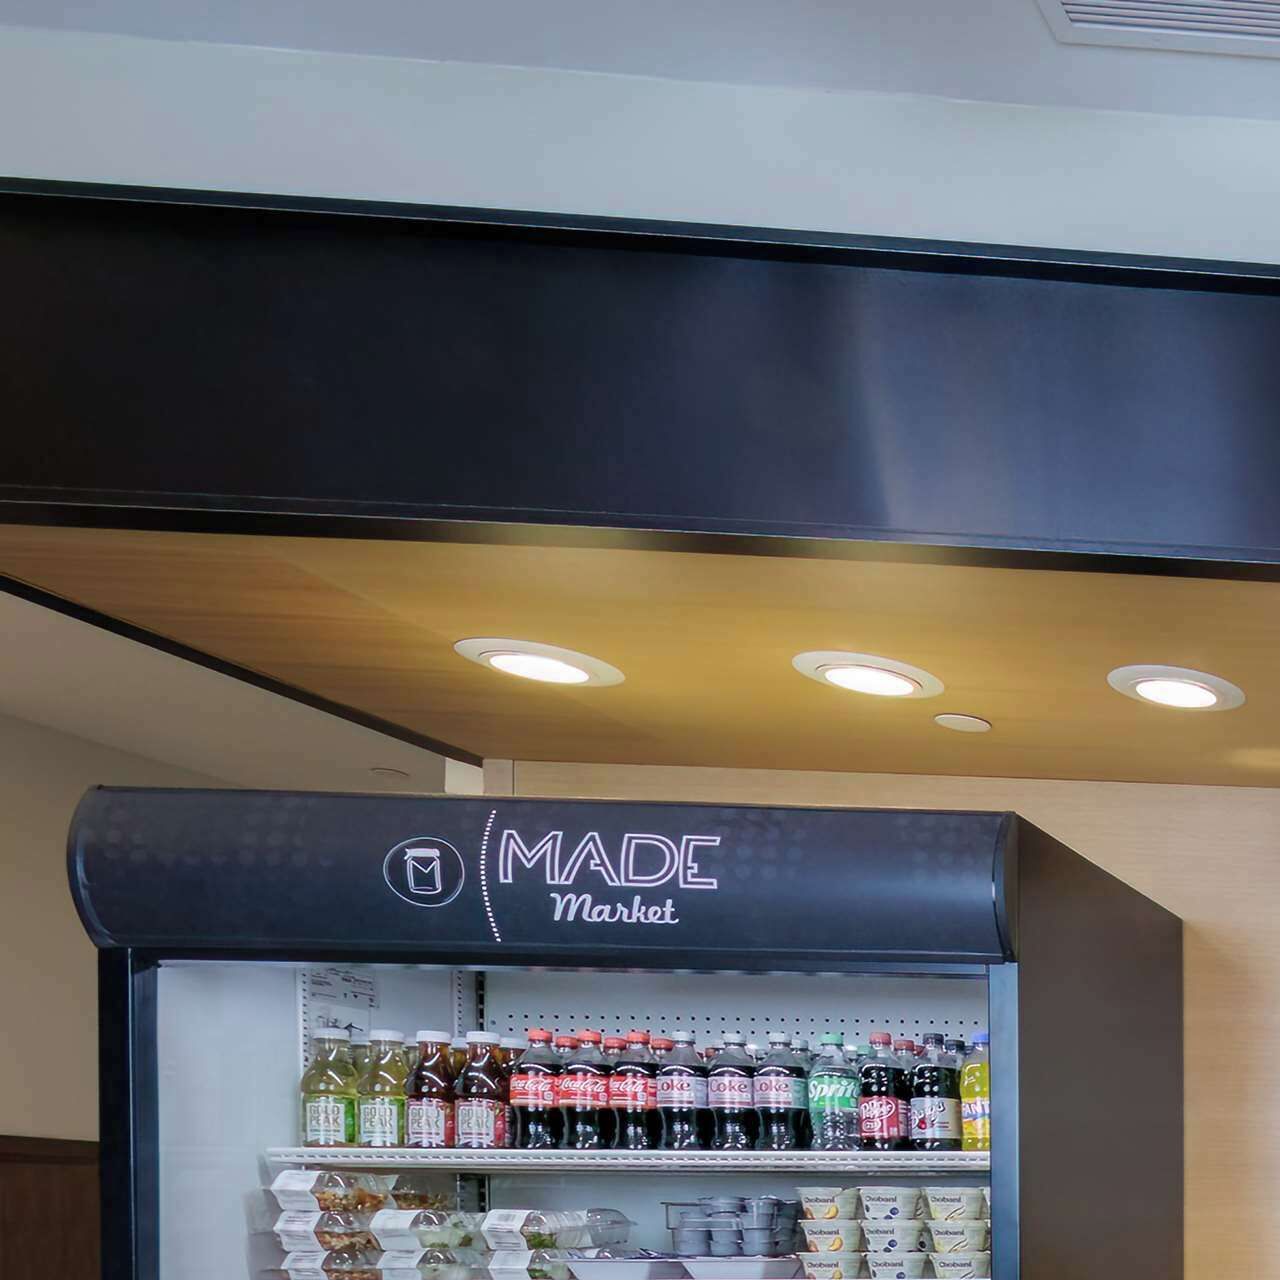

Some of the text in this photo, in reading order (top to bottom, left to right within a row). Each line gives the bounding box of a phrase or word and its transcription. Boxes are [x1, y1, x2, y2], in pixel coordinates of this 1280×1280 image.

[498, 829, 722, 890] MADE
[550, 891, 681, 927] Market
[610, 1076, 645, 1092] oca-Cola
[710, 1080, 747, 1093] Coke
[754, 1080, 788, 1093] oke
[309, 1105, 340, 1116] GOLD
[363, 1106, 393, 1117] GOLD
[410, 1107, 441, 1118] GOLD
[458, 1107, 489, 1118] GOLD
[962, 1101, 990, 1115] FANT
[310, 1117, 340, 1127] PEAK
[363, 1118, 393, 1128] PEAK
[410, 1118, 440, 1129] PEAK
[458, 1118, 489, 1129] PEAK
